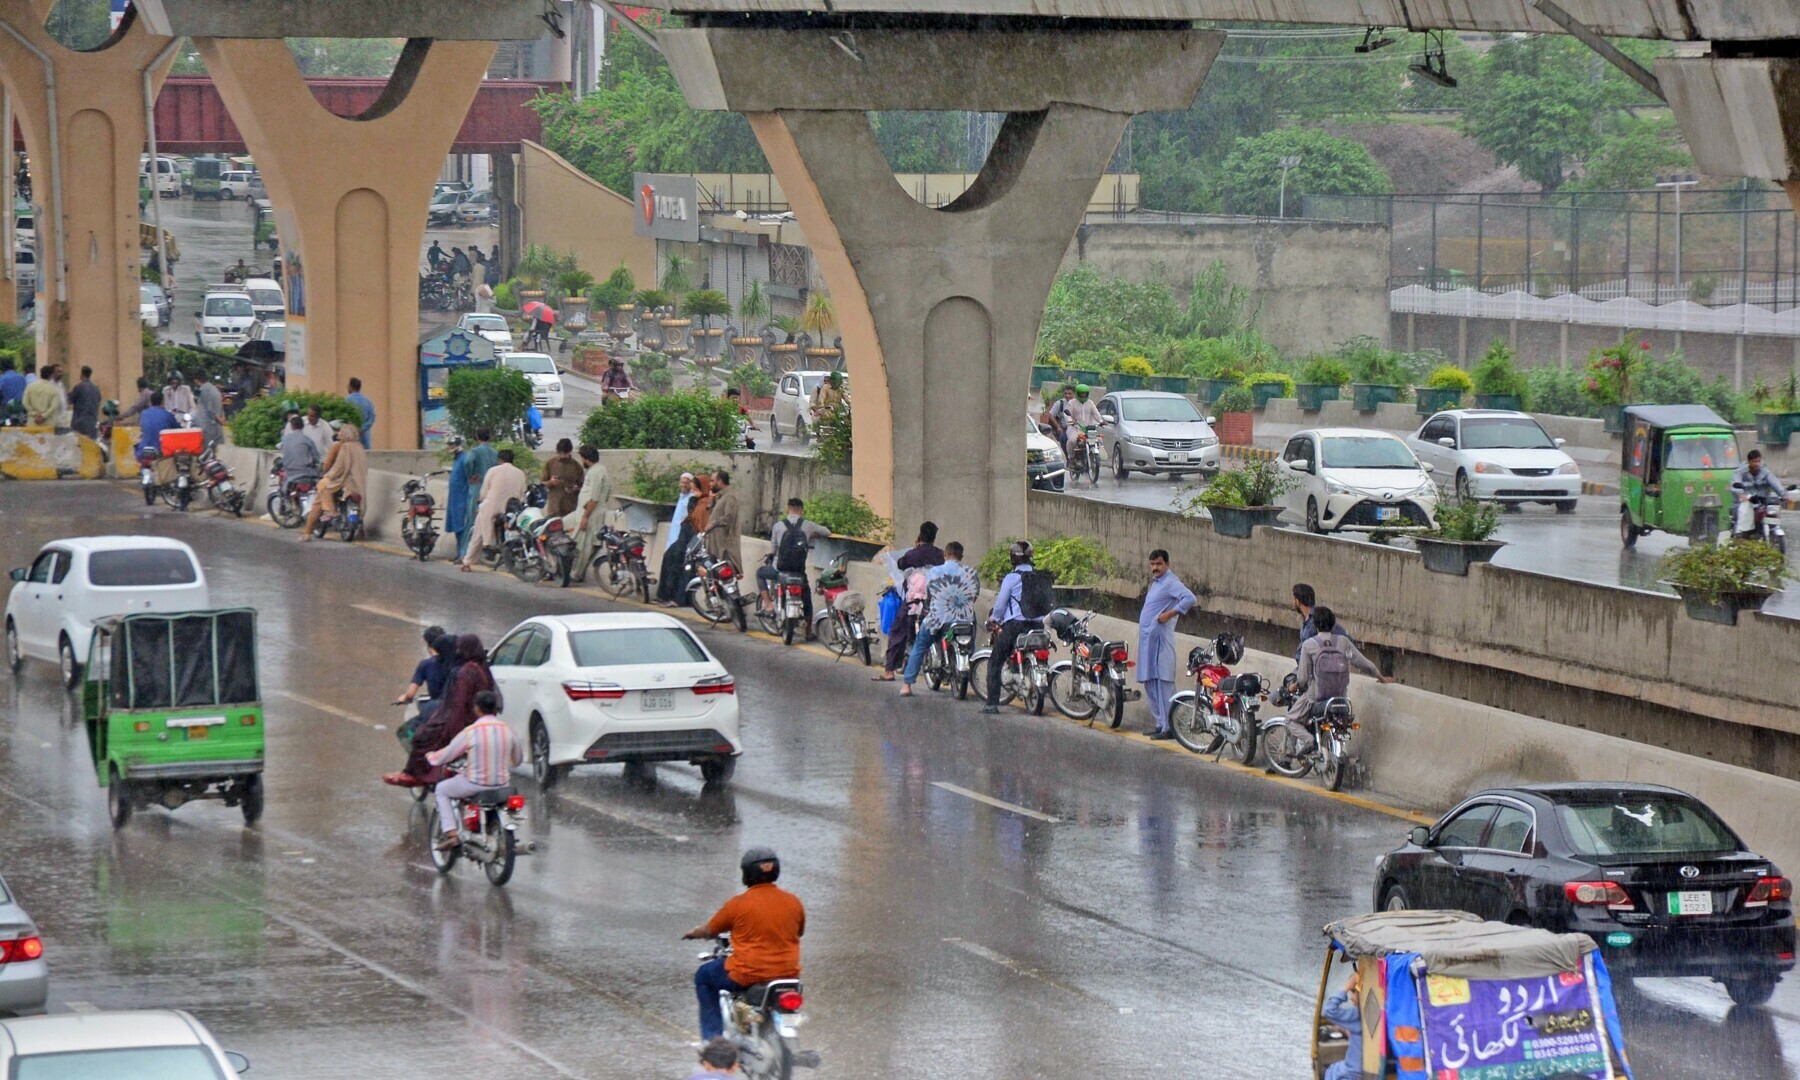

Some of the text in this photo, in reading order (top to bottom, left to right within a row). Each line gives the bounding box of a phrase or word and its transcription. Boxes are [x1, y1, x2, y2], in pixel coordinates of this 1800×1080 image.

[1684, 903, 1707, 912] 1523
[1608, 935, 1632, 944] PRESS
[1497, 975, 1559, 1015] اردو
[1441, 1011, 1526, 1070] لکھائی
